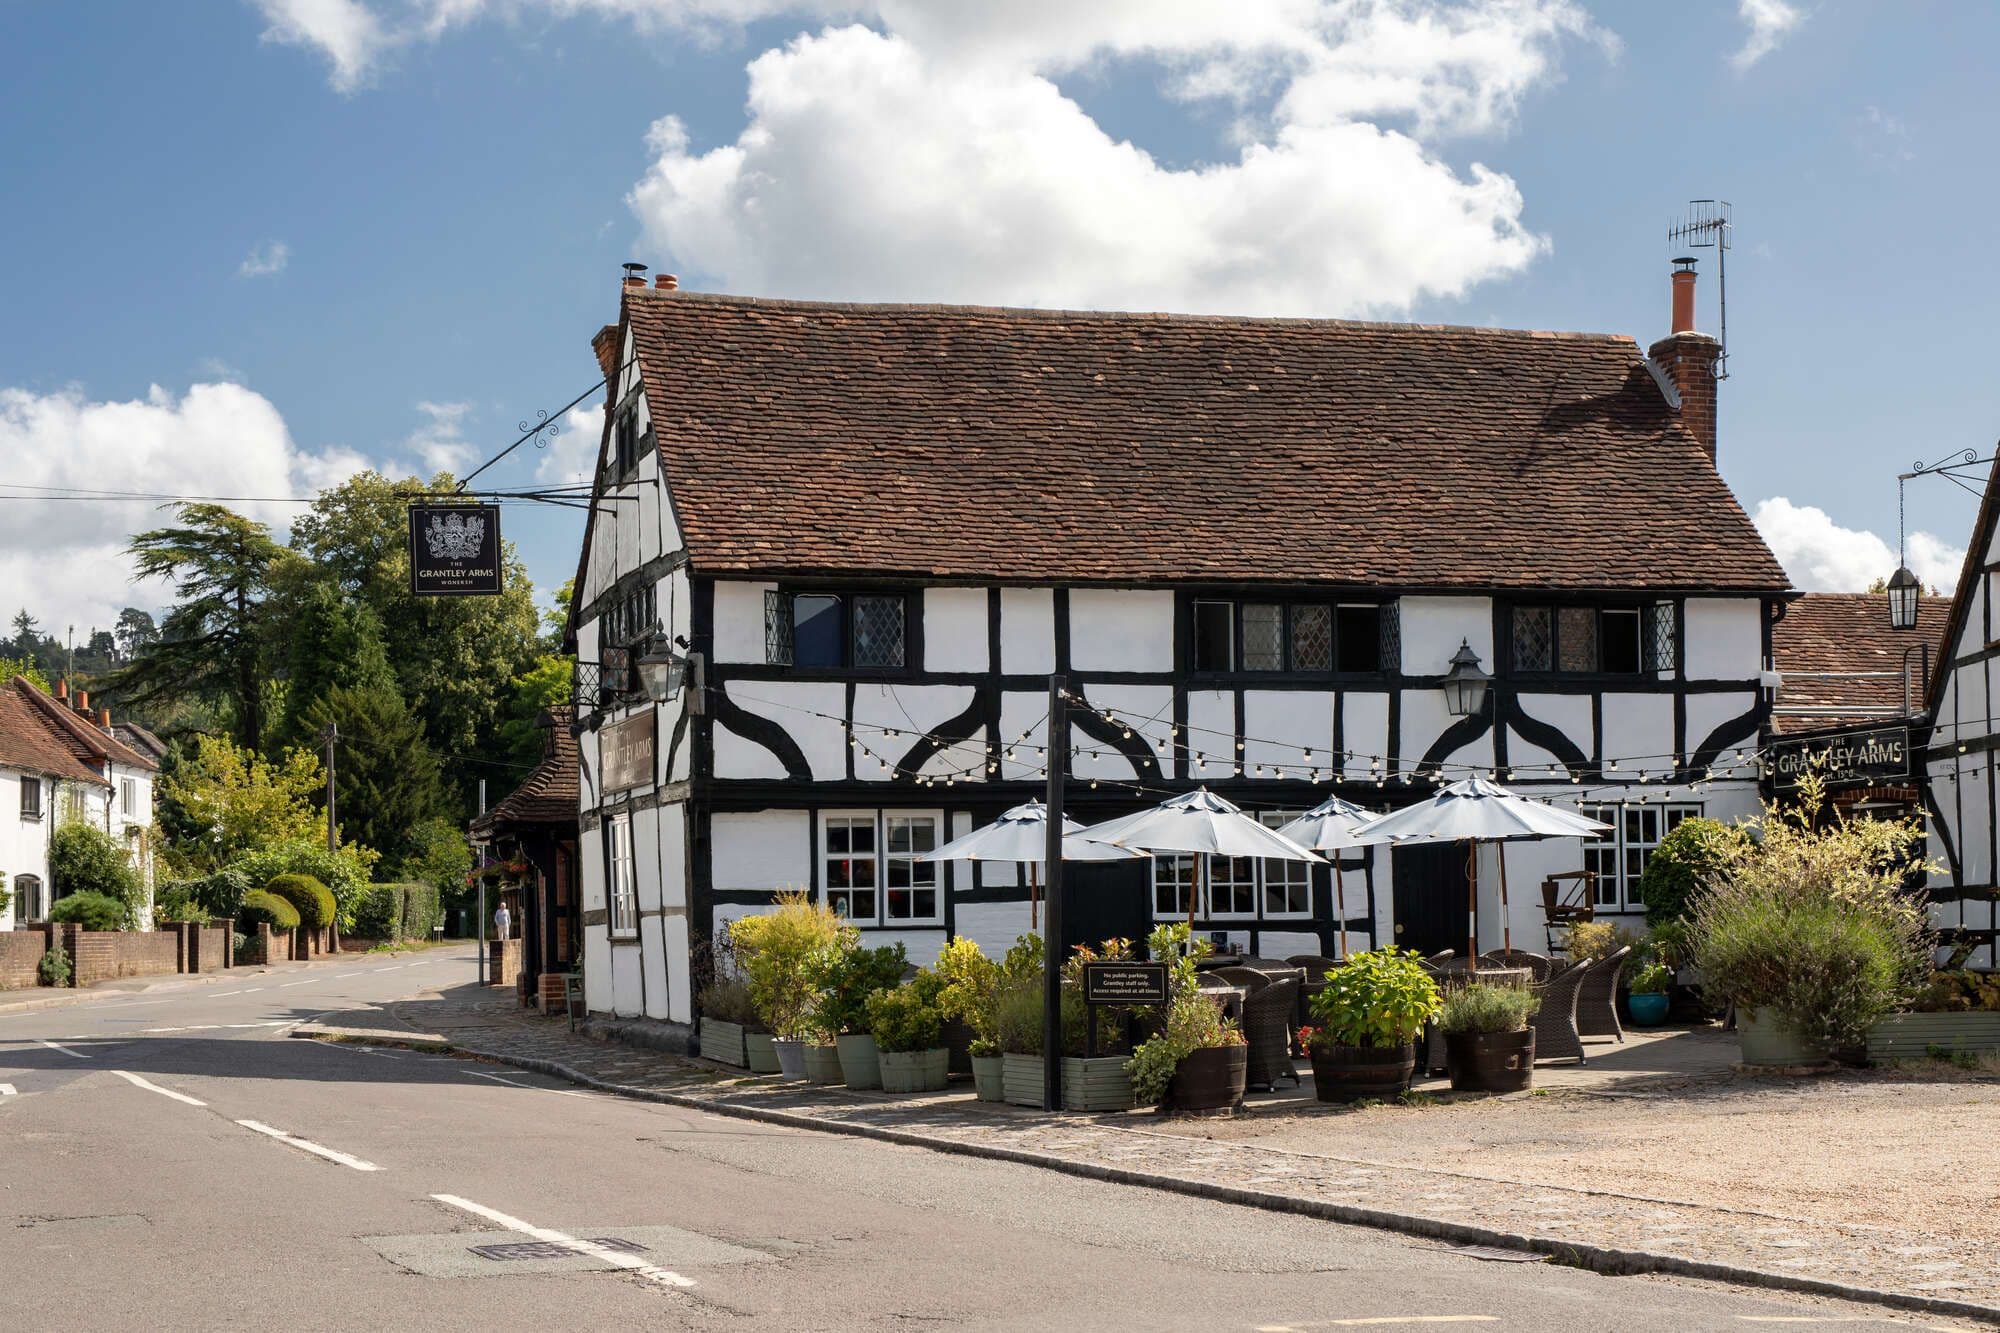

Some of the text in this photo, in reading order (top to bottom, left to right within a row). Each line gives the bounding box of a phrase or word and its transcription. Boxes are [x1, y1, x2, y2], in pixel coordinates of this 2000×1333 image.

[419, 569, 494, 578] GRANTLEY ARMS
[1830, 737, 1846, 746] THE
[603, 737, 652, 770] GRANTLEY ARMS
[1857, 741, 1903, 766] ARMS
